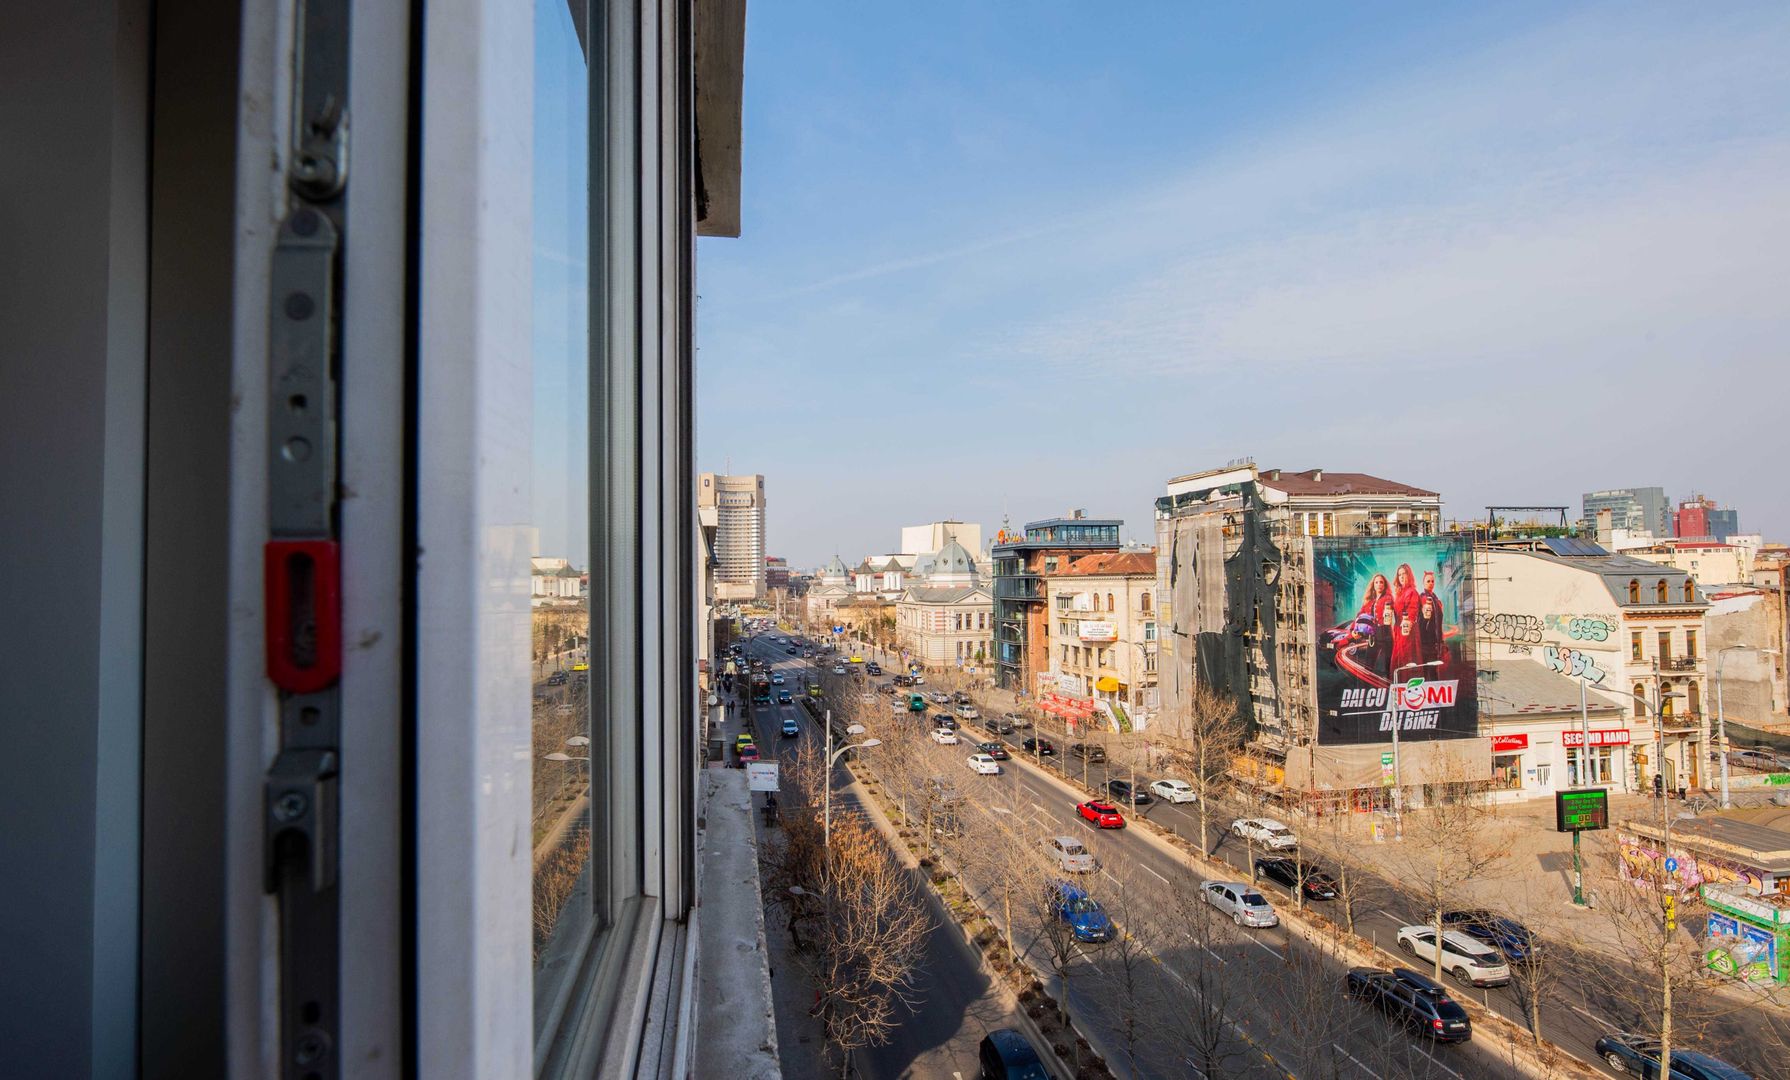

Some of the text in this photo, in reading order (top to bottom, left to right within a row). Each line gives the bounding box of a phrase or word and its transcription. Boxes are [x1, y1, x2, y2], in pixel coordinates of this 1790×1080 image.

[1340, 683, 1453, 711] DAI CU TOMI
[1403, 710, 1440, 731] BINE!
[1563, 731, 1629, 746] SECND HAND
